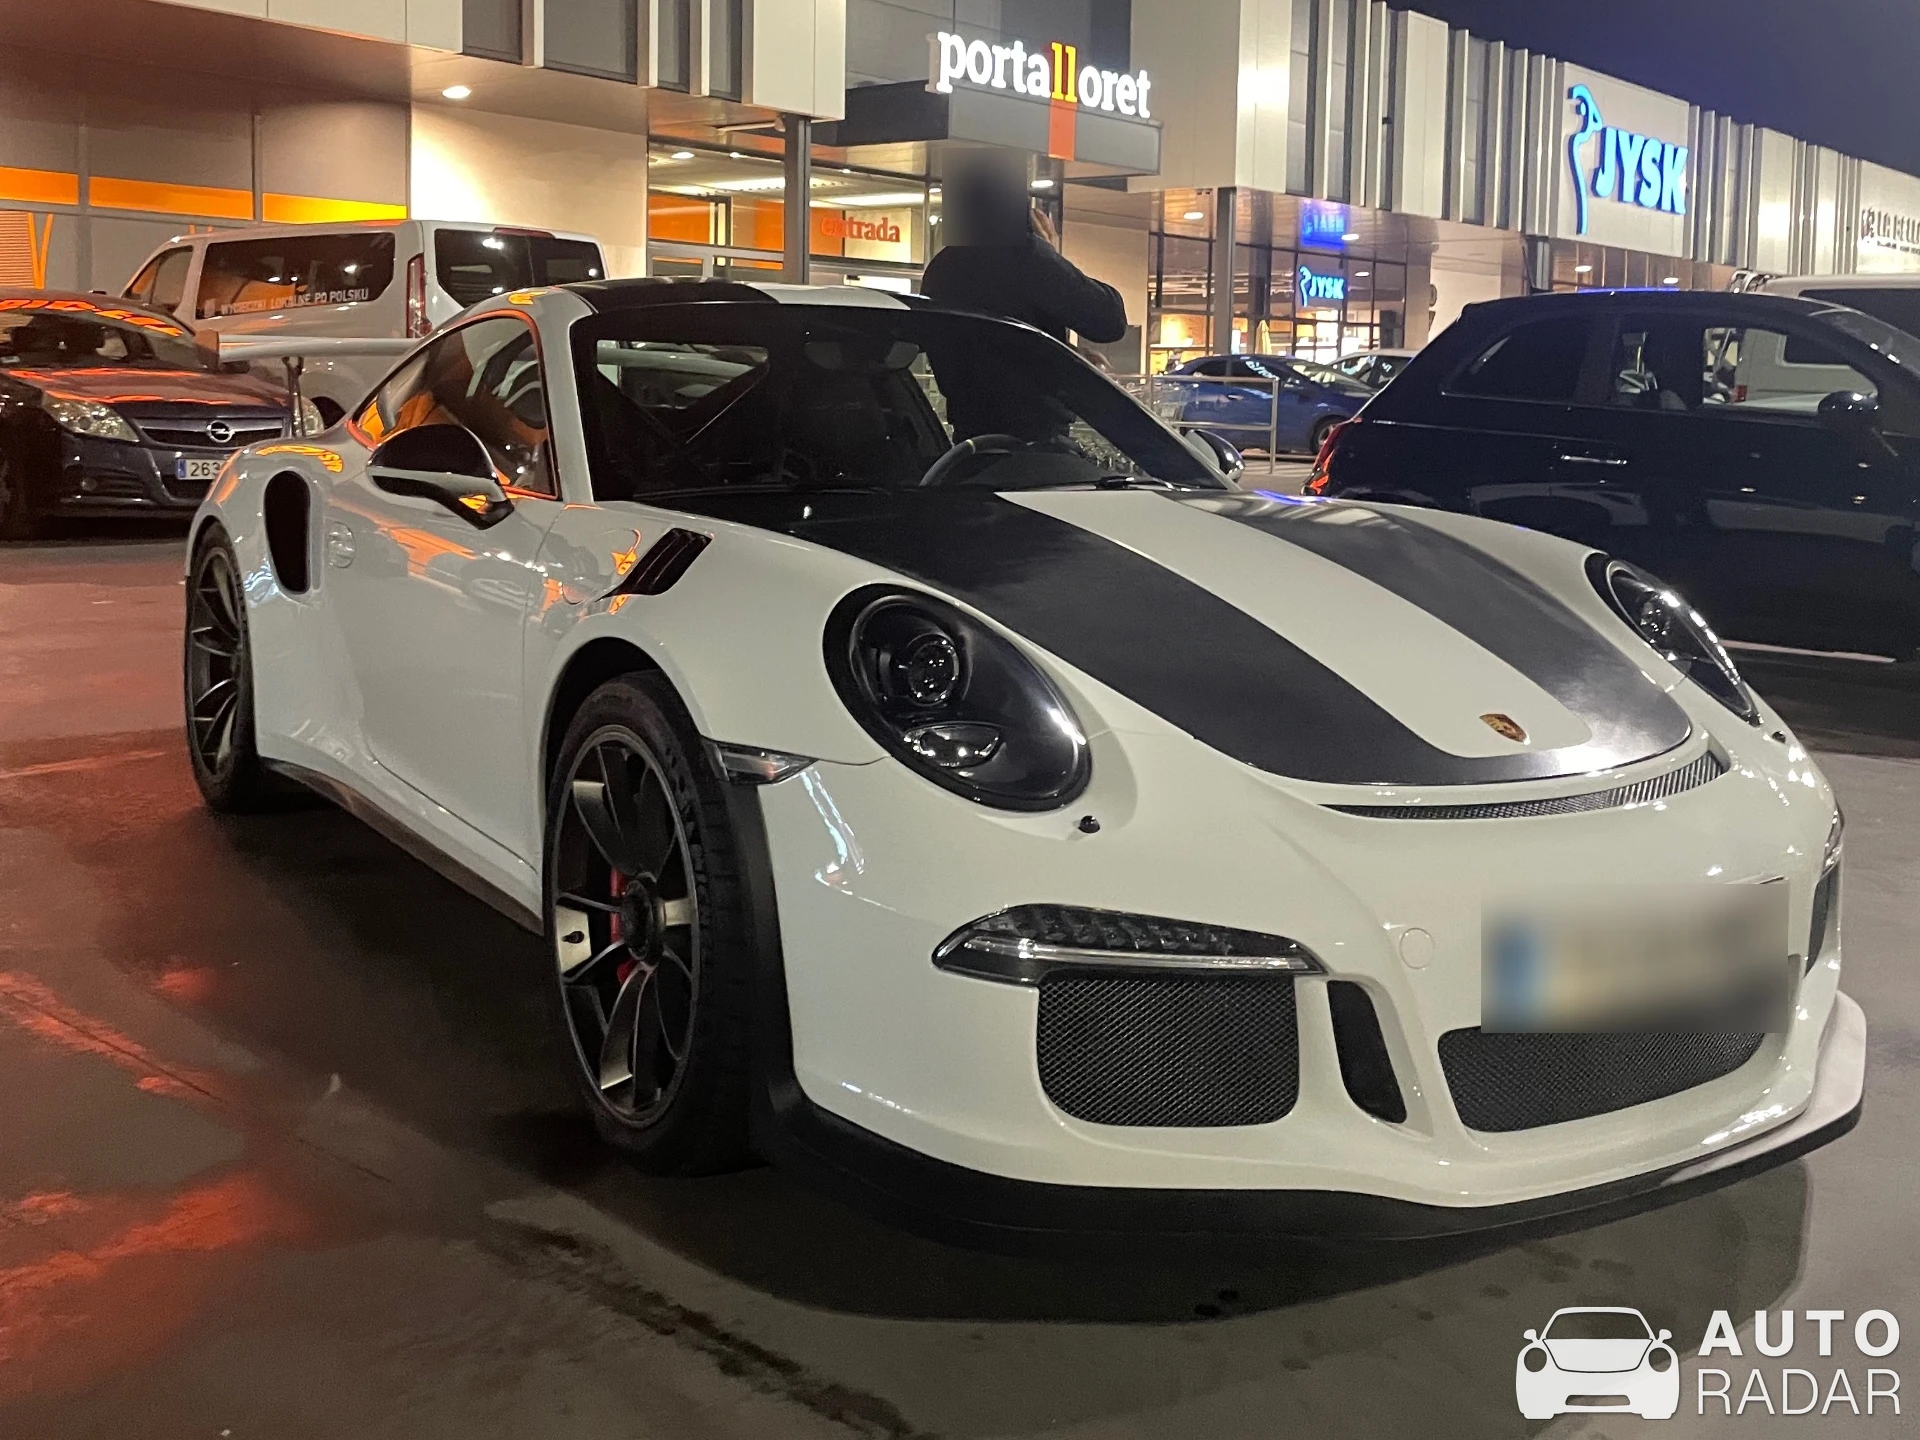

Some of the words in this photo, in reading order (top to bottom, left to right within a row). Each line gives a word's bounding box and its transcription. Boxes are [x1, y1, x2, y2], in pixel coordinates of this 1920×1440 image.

[936, 31, 1151, 119] portalloret
[1593, 126, 1688, 215] JYSK
[821, 217, 900, 242] entrada
[314, 291, 328, 304] PO
[329, 287, 369, 303] POLSKU
[1309, 276, 1344, 300] JYSK
